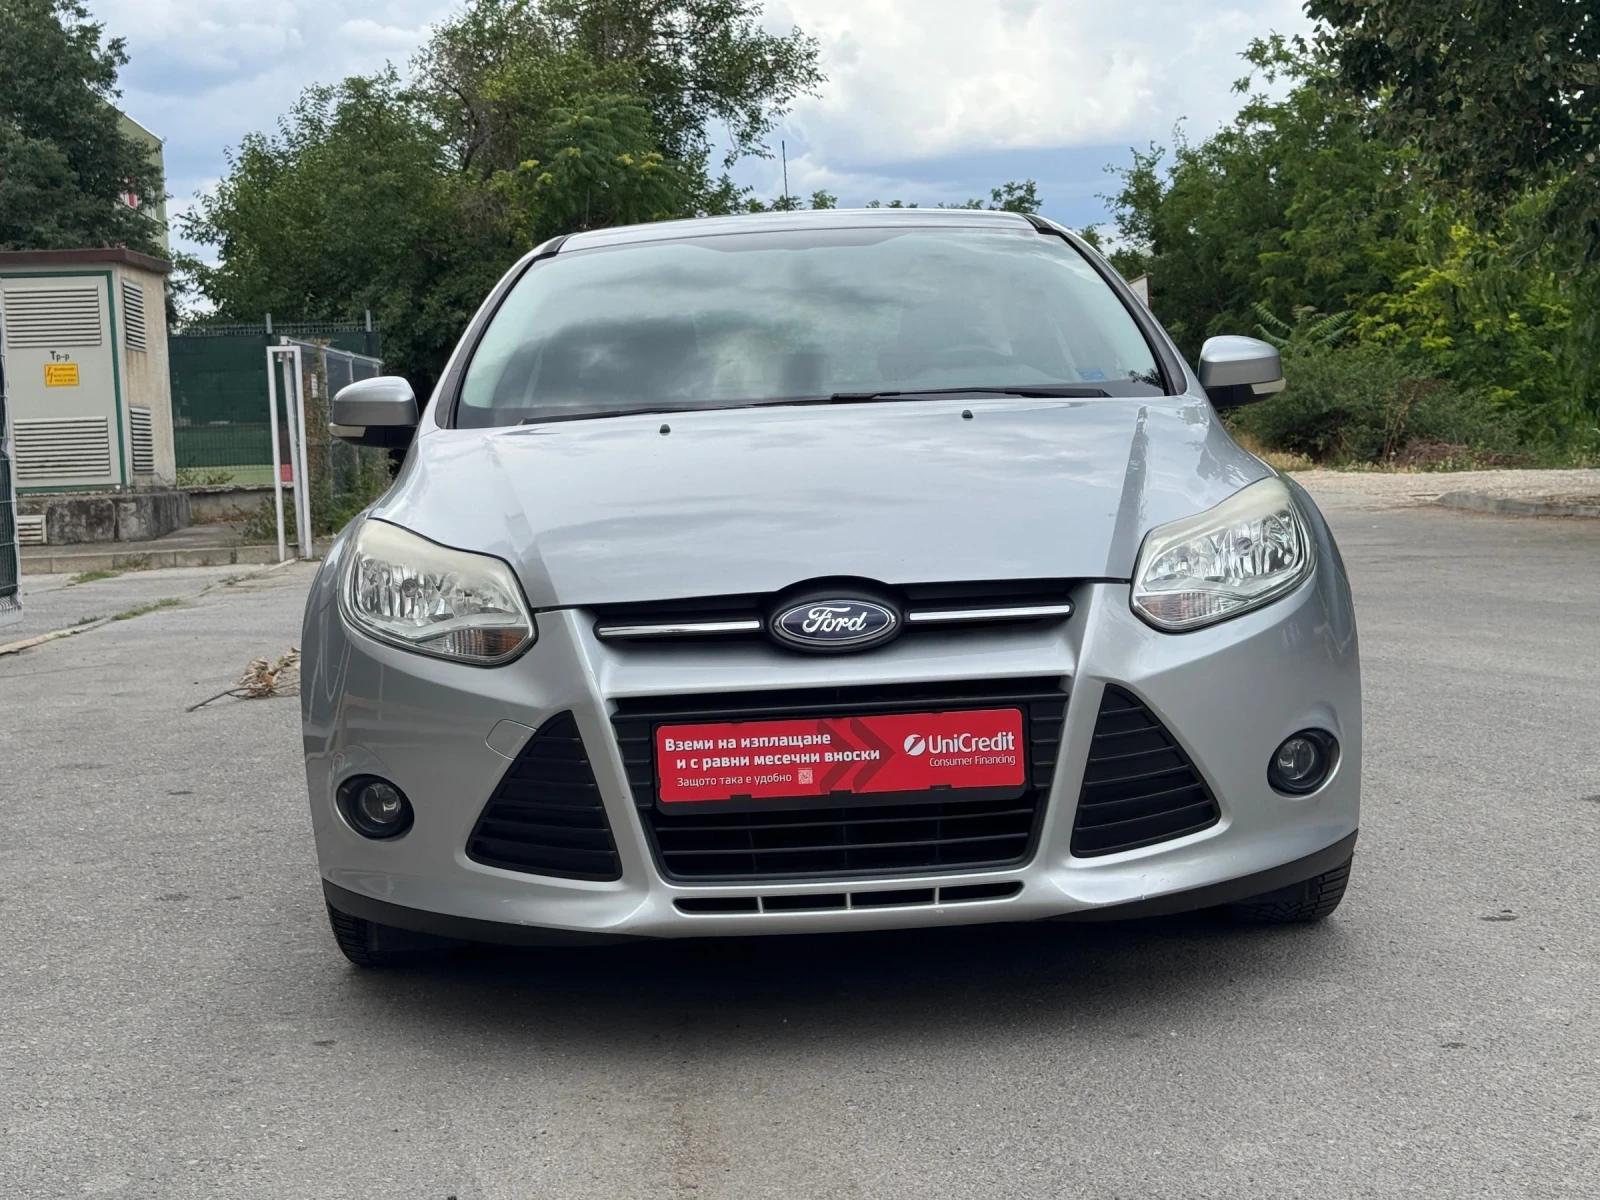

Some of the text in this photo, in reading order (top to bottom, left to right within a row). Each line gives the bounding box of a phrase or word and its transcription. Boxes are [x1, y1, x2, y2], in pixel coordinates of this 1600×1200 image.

[802, 606, 867, 633] Ford
[665, 734, 831, 752] Вземи на изплащане
[928, 731, 1015, 754] UniCredit
[676, 749, 880, 771] и с равни месечни вноски
[929, 754, 1016, 767] Consumer Financing
[677, 773, 792, 787] Защото така е удобно
